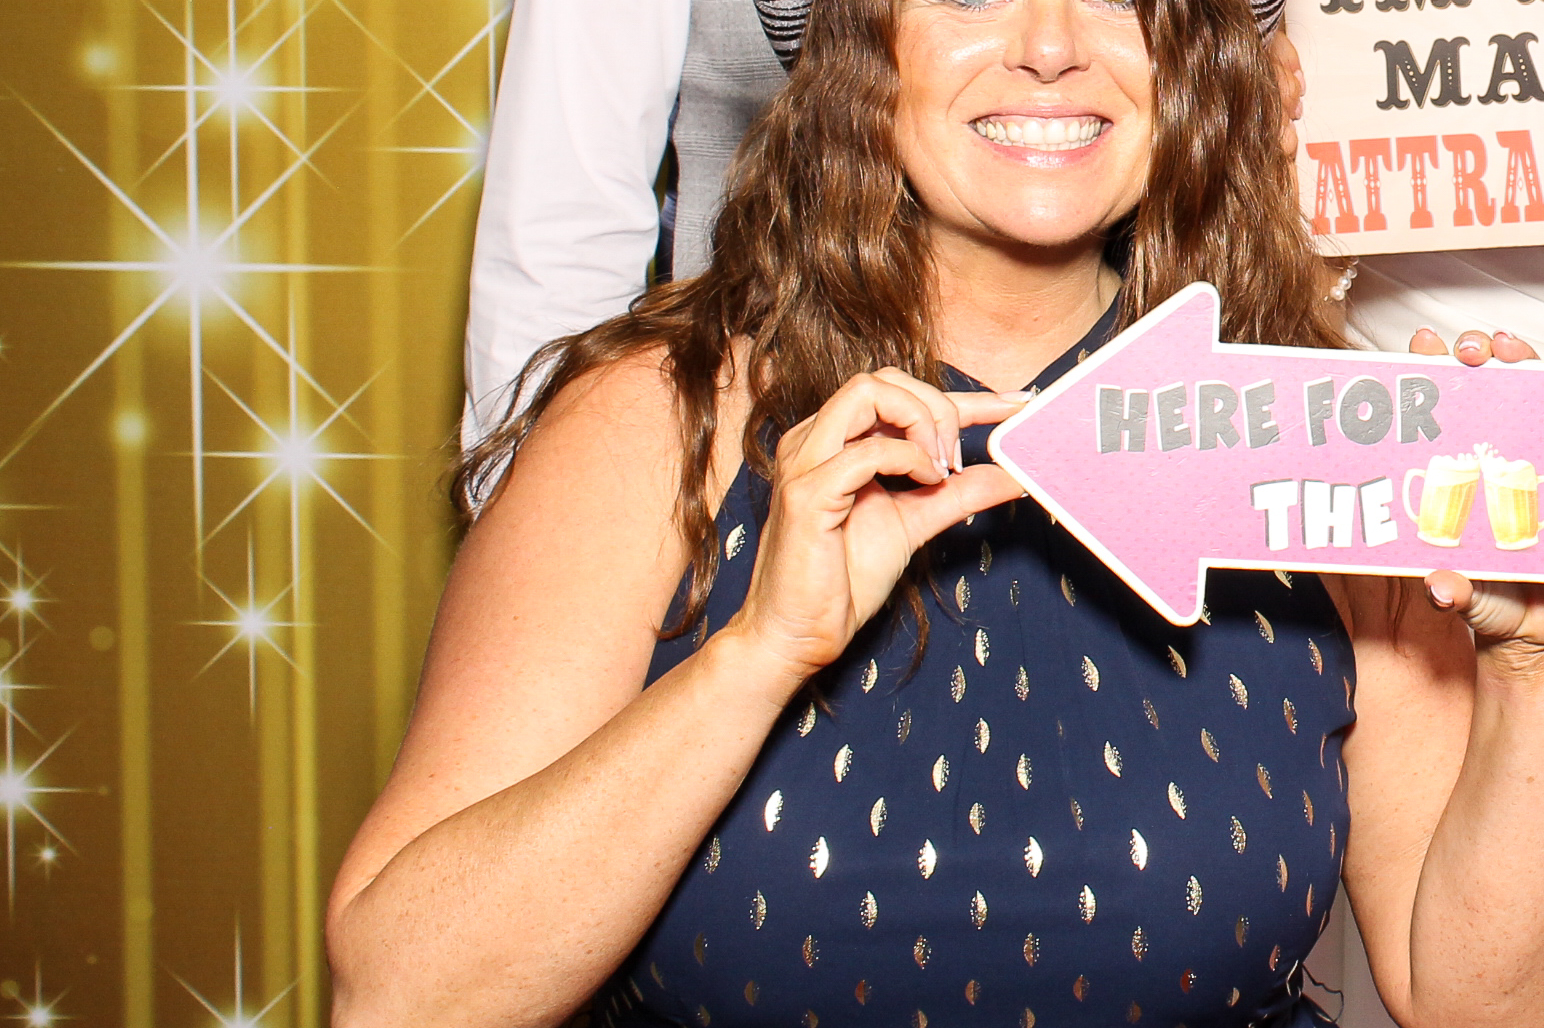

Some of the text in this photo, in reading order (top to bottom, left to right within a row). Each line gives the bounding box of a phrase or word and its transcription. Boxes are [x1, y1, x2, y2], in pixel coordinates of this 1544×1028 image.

[1096, 375, 1443, 454] HERE FOR
[1250, 475, 1399, 551] THE
